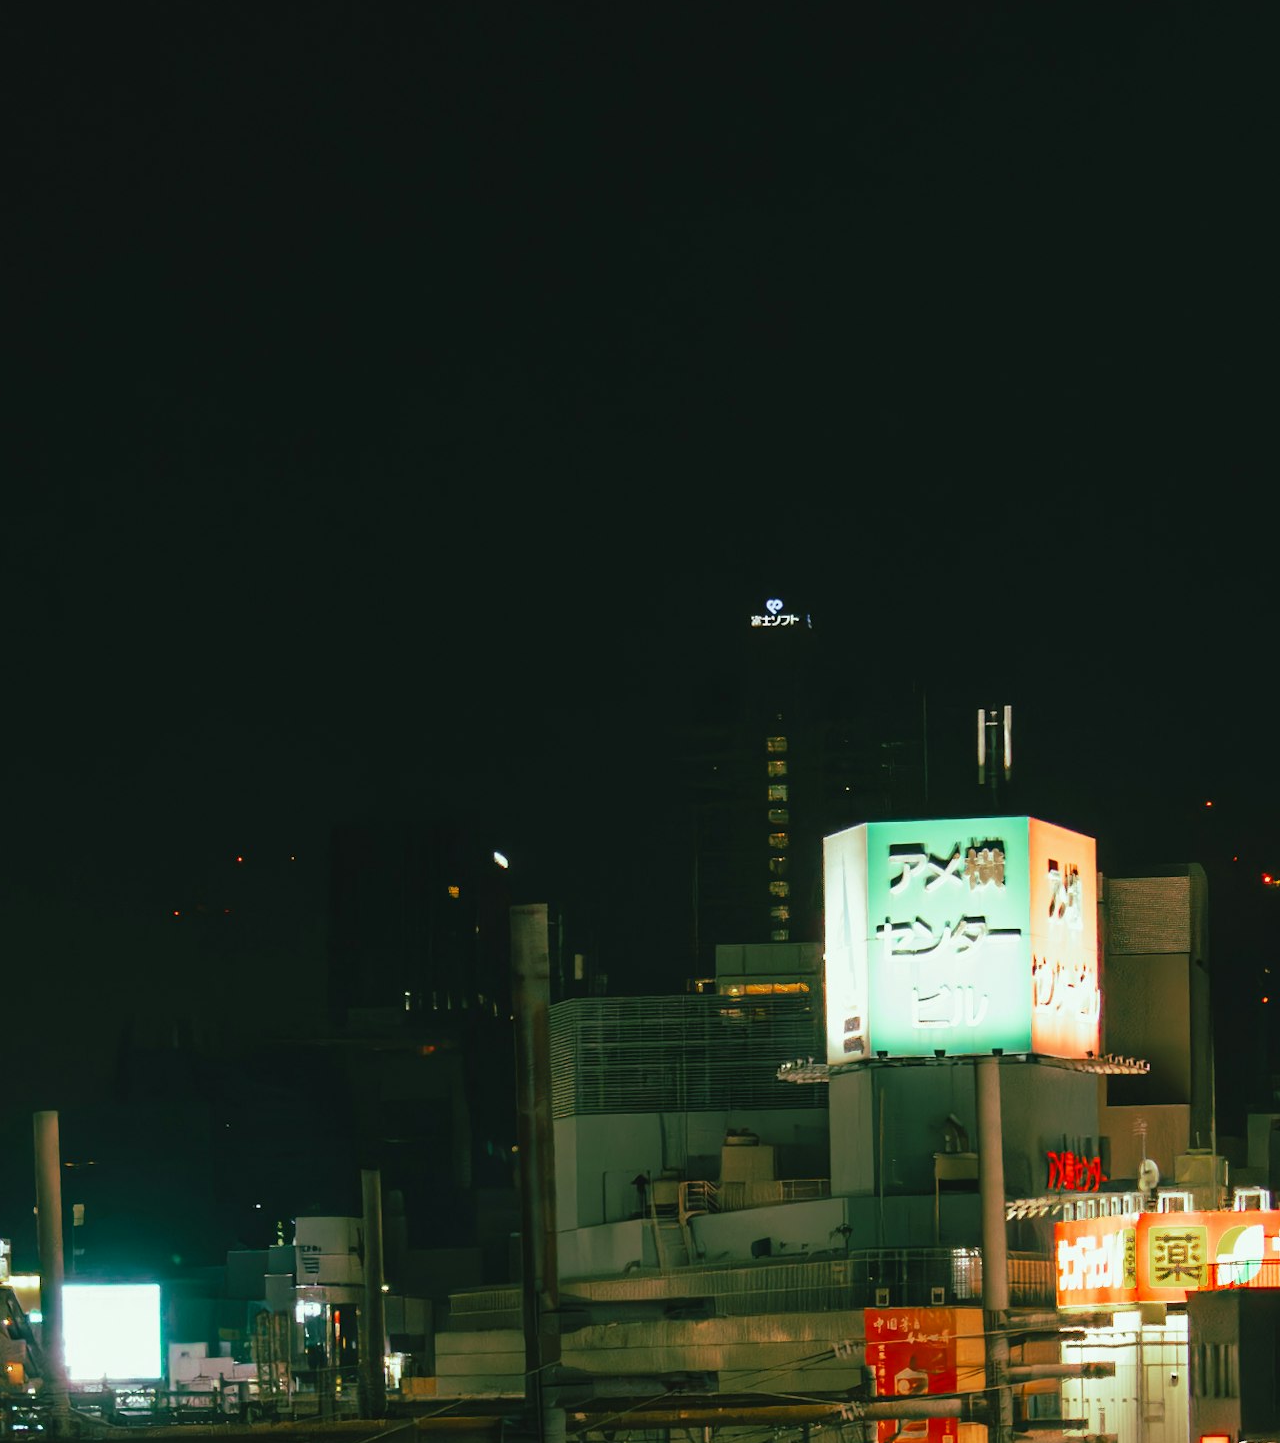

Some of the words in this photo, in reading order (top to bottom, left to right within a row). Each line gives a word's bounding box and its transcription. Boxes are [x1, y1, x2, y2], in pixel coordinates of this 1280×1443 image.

[750, 614, 800, 626] 富士ソフト
[875, 915, 1021, 958] センター
[1154, 1235, 1204, 1282] 薬
